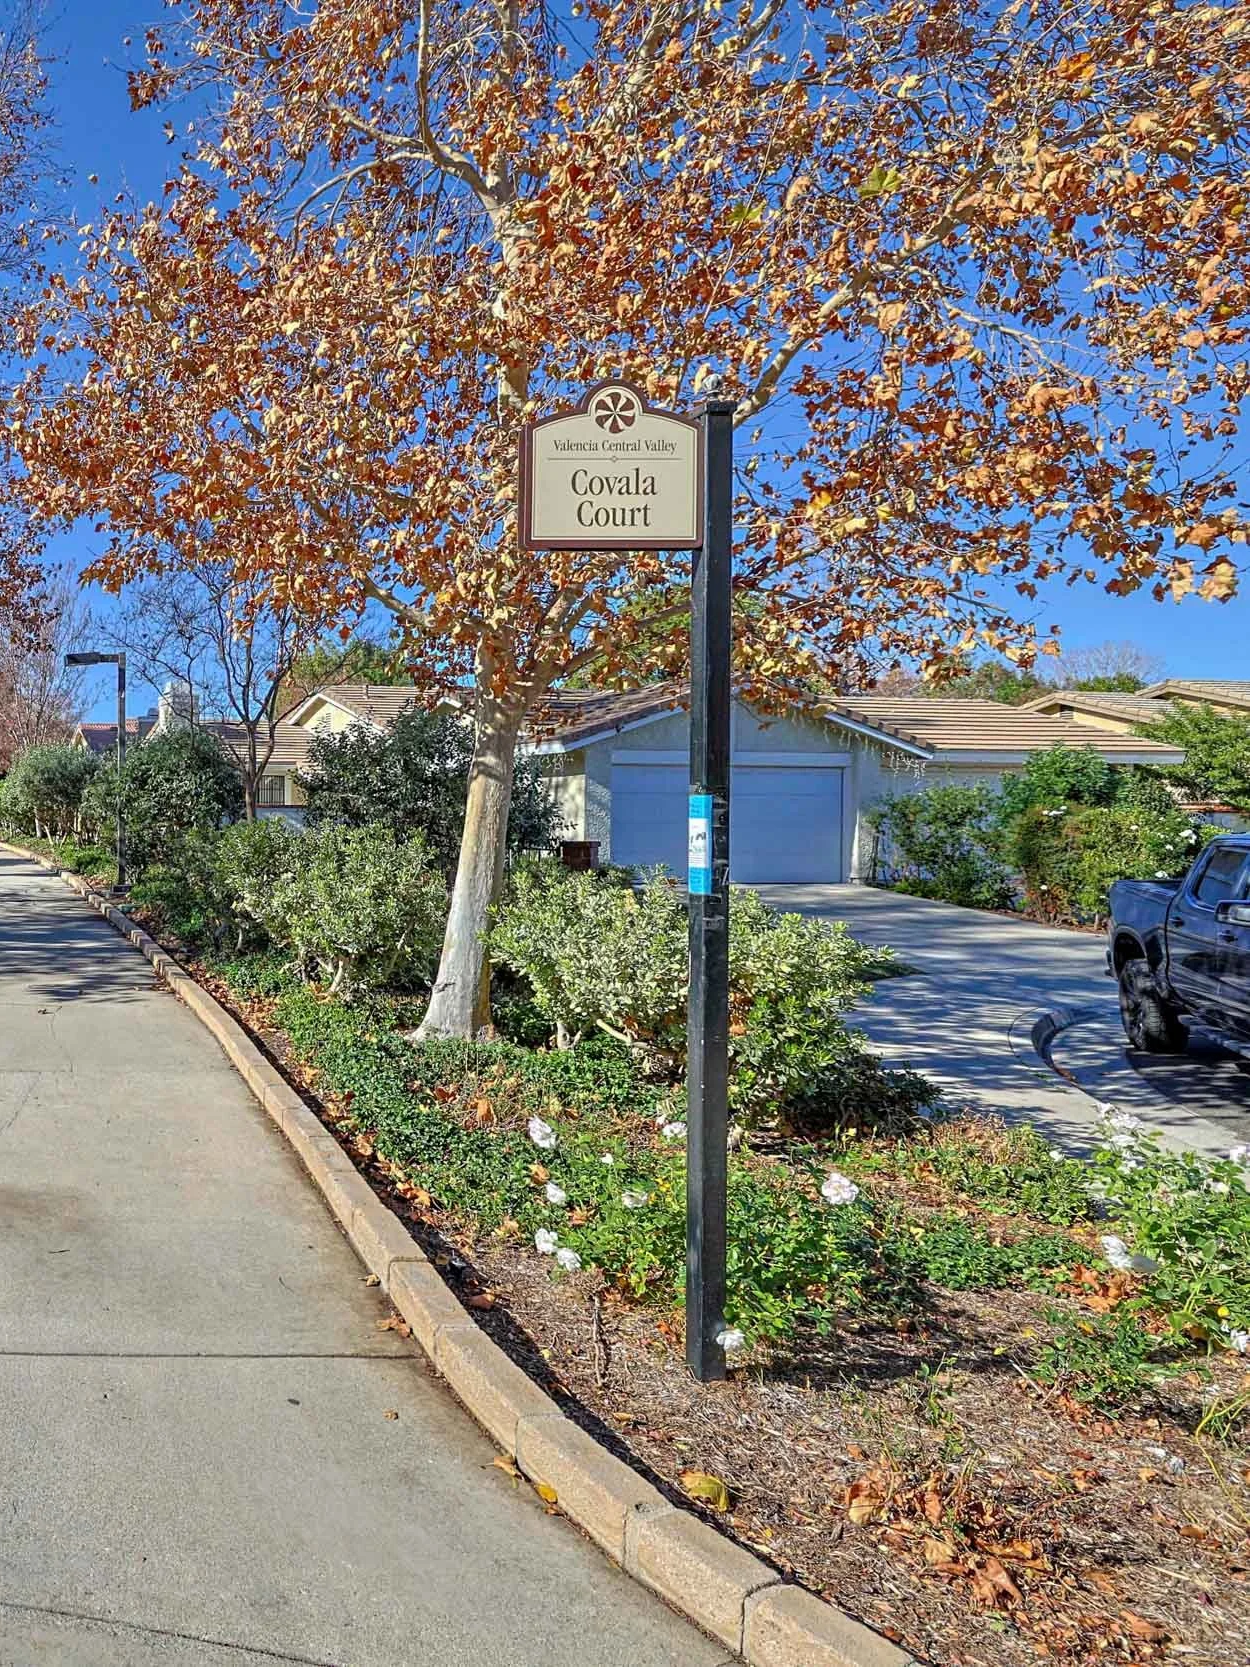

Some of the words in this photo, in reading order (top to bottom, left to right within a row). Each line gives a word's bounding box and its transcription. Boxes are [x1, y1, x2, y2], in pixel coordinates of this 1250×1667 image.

[553, 439, 598, 451] Valencia
[601, 439, 641, 451] Central
[644, 439, 677, 455] Valley
[571, 467, 657, 496] Covala
[576, 500, 652, 527] Court
